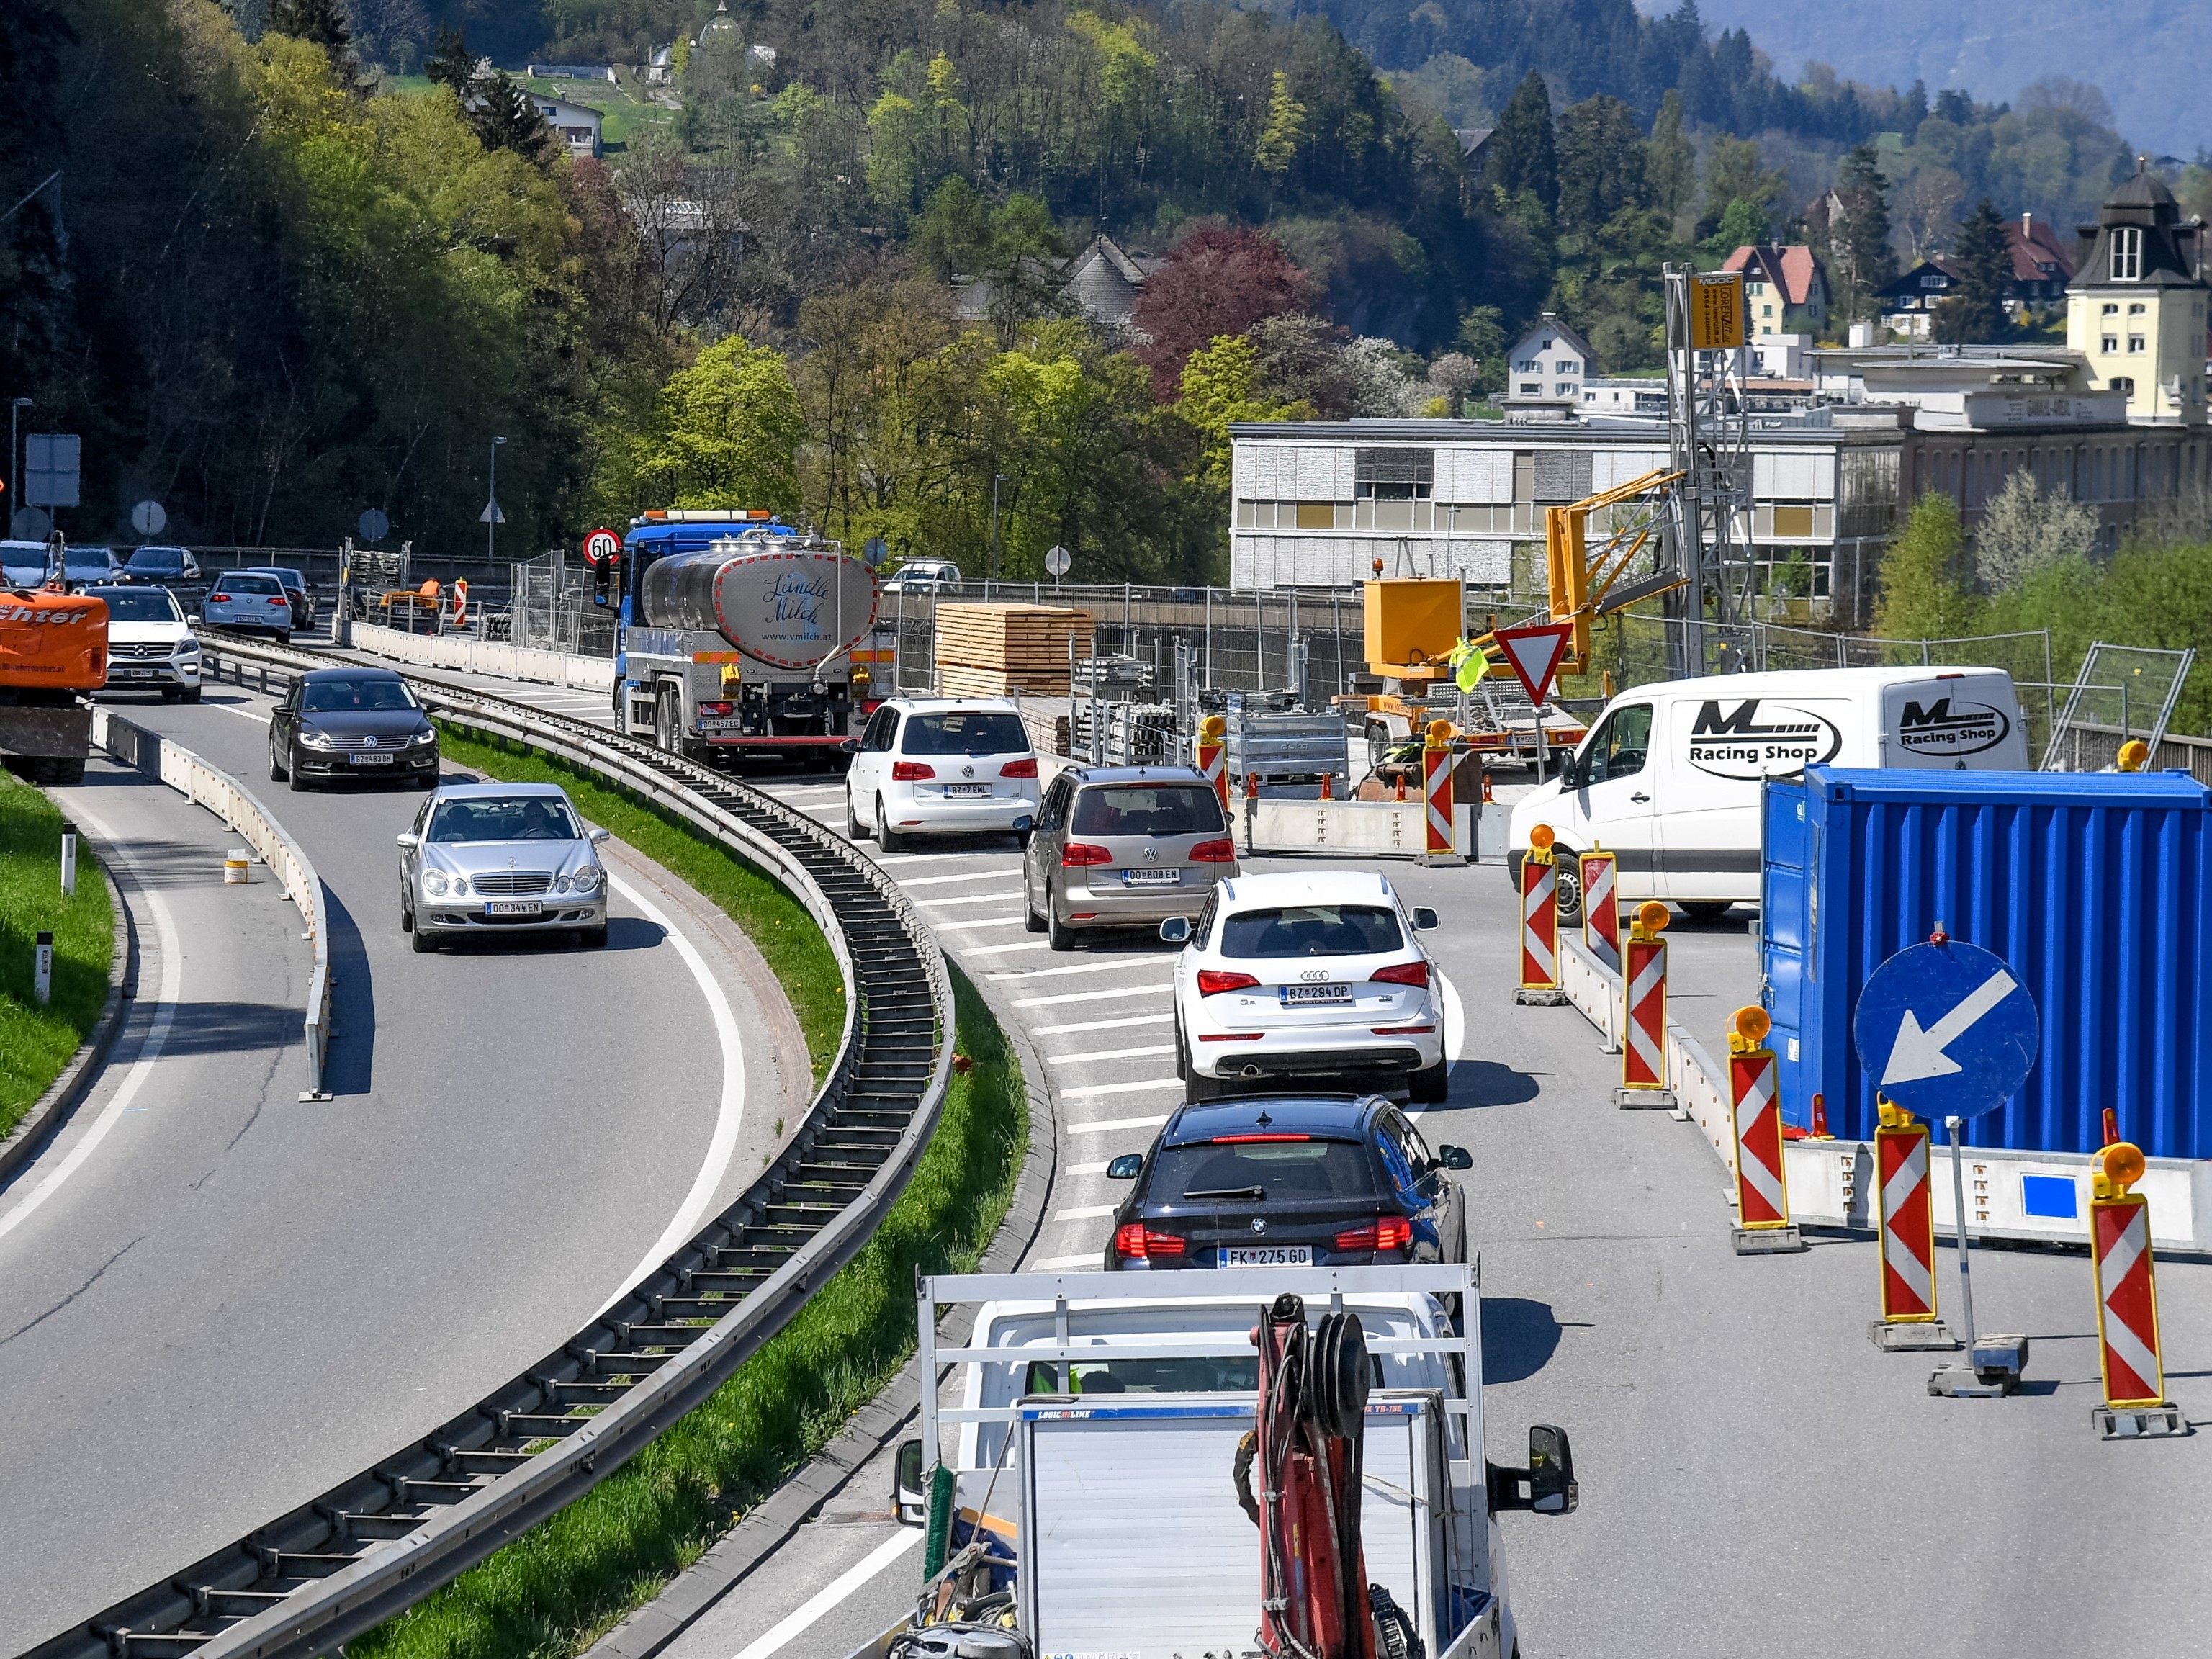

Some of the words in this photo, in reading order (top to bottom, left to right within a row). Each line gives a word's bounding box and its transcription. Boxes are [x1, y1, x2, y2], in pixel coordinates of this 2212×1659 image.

[593, 538, 612, 557] 60
[763, 573, 830, 602] Ländle
[765, 597, 824, 624] Milch
[1901, 732, 1956, 745] Racing
[1959, 729, 1995, 743] Shop
[1690, 746, 1758, 763] Racing
[1765, 746, 1817, 762] Shop
[1290, 988, 1303, 999] BZ
[1312, 987, 1331, 998] 294
[1334, 986, 1348, 997] DP
[1231, 1250, 1247, 1264] FK
[1259, 1250, 1285, 1264] 275
[1289, 1249, 1306, 1263] GD
